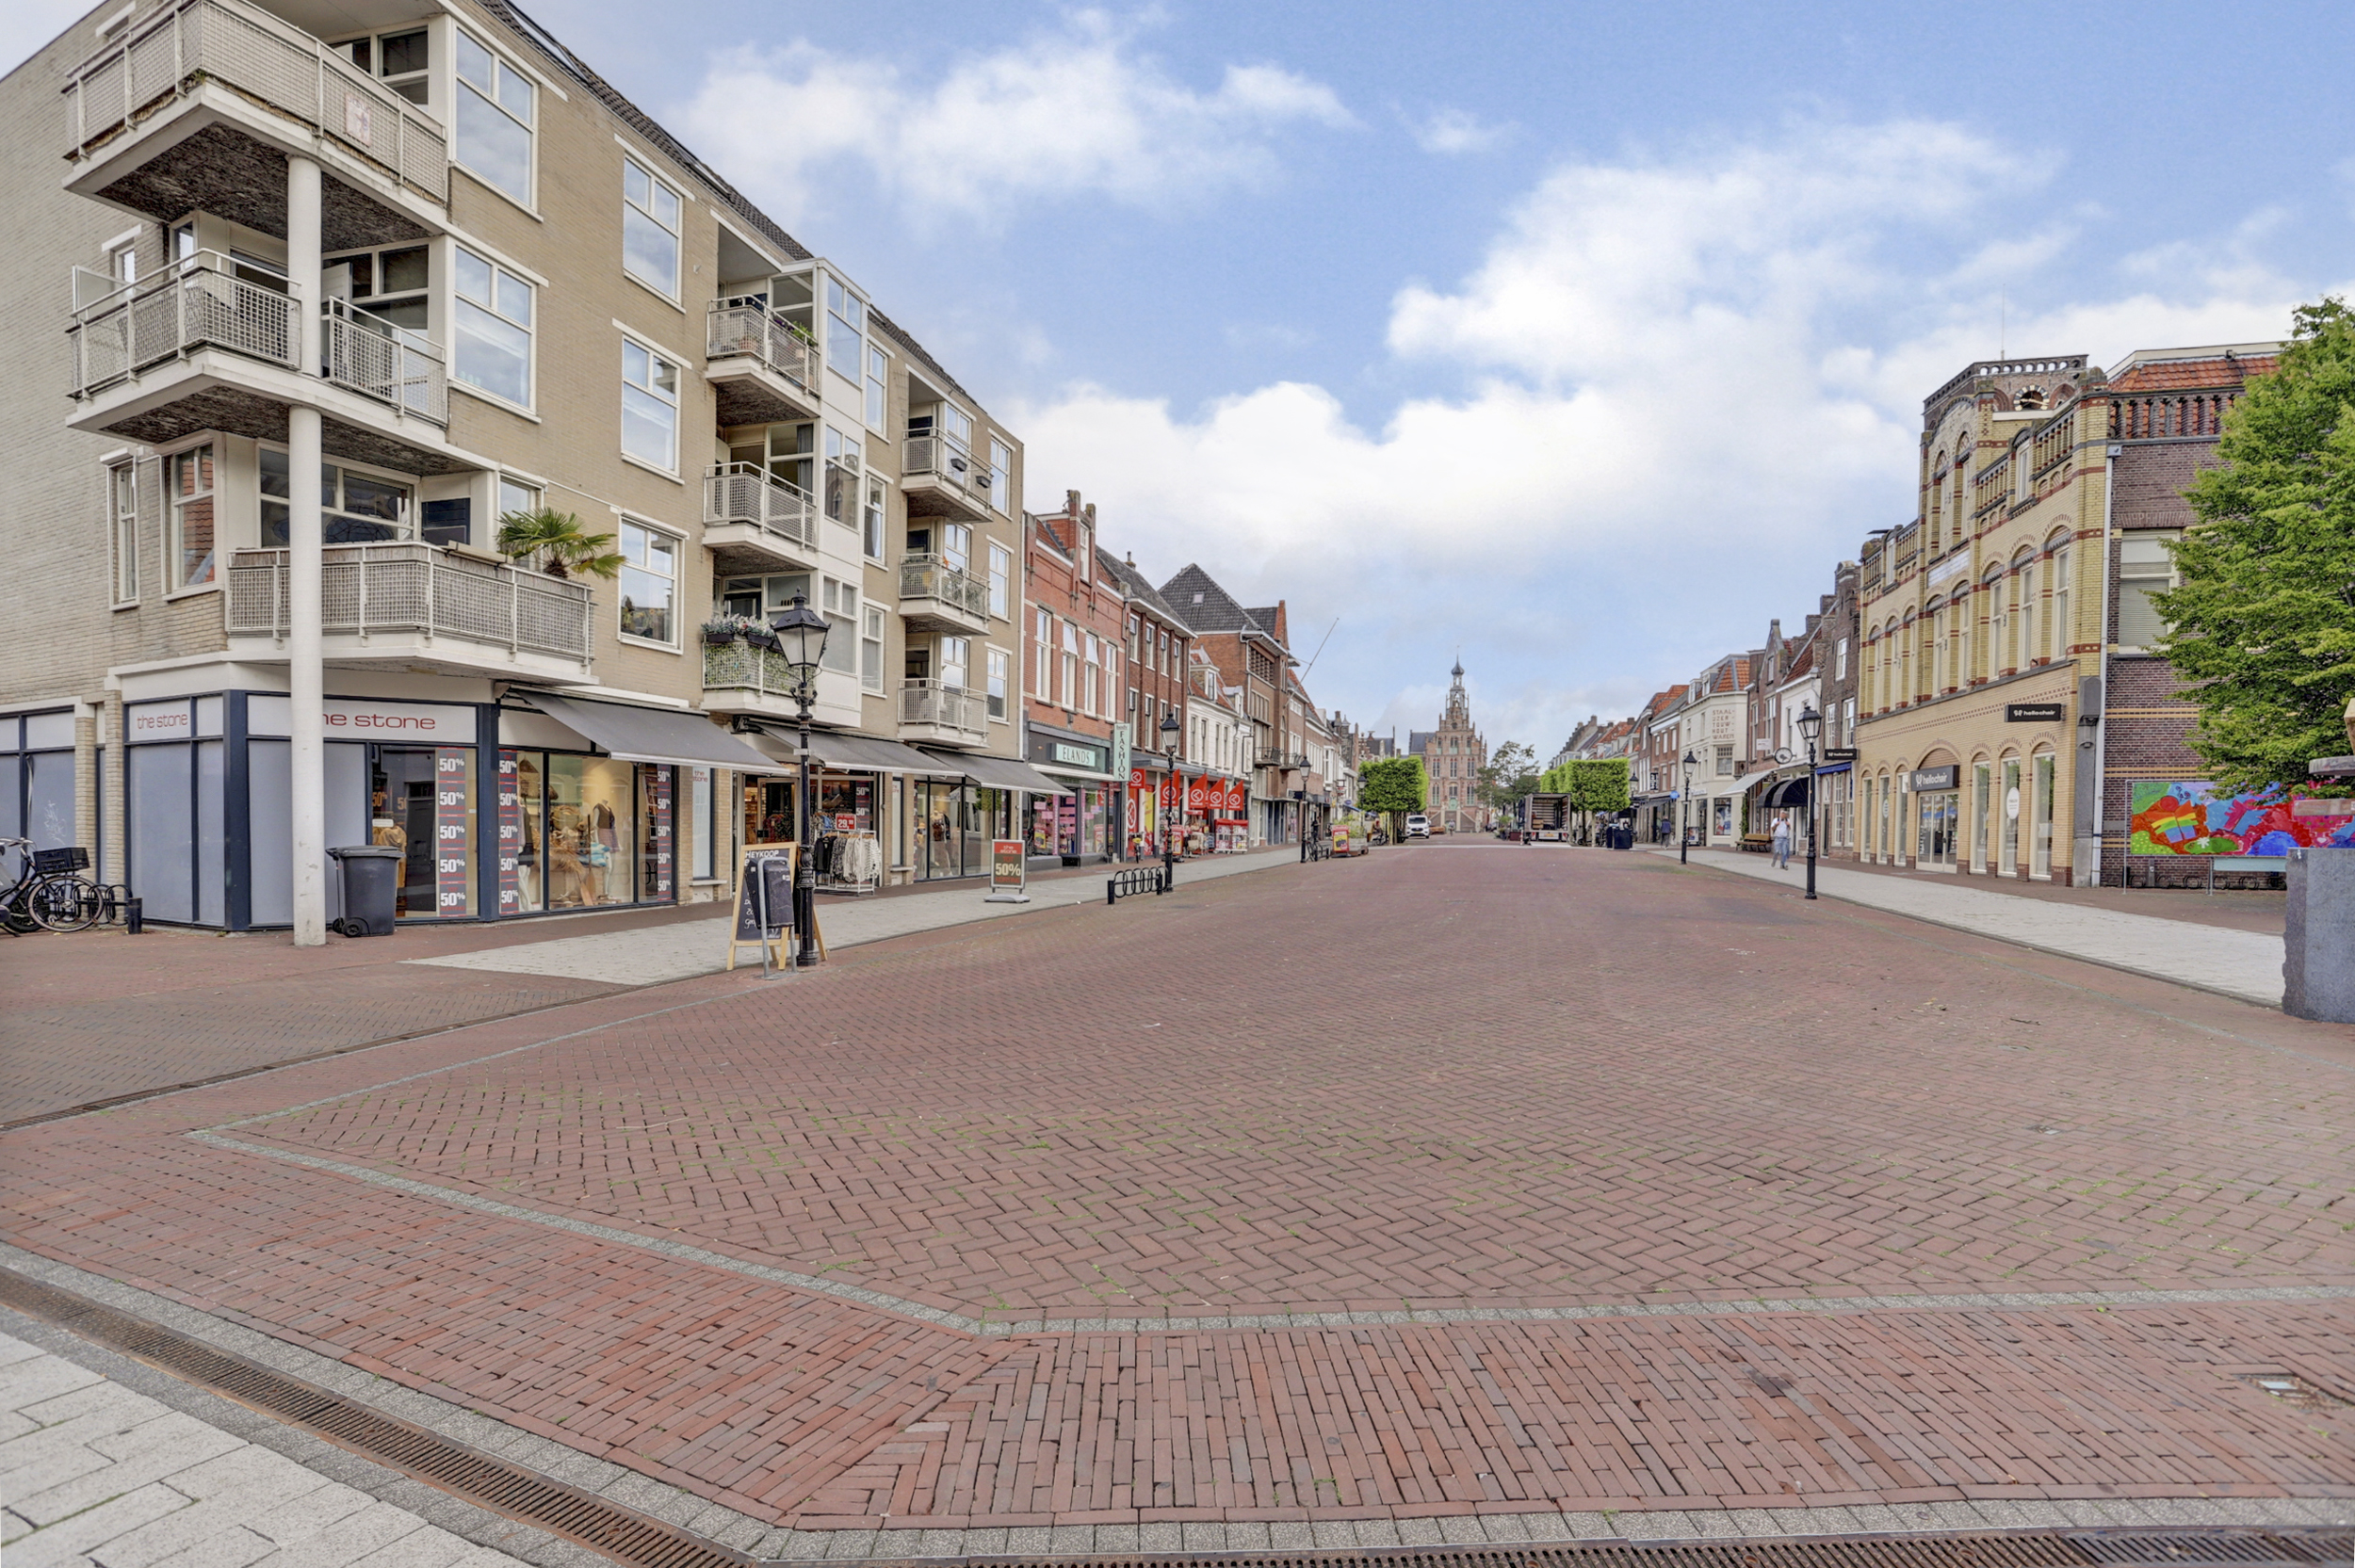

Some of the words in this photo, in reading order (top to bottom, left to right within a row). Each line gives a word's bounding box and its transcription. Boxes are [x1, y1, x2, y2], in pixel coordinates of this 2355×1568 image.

[137, 715, 155, 730] the
[156, 713, 188, 728] stone
[354, 713, 436, 730] stone
[1063, 747, 1090, 765] ELANDS
[1117, 731, 1126, 780] FASHION
[439, 757, 465, 772] 50%
[499, 760, 518, 774] 50%
[1923, 771, 1948, 785] hellochair
[439, 791, 465, 806] 50%
[499, 793, 518, 807] 50%
[439, 825, 465, 840] 50%
[499, 825, 518, 839] 50%
[745, 849, 779, 858] HEYKOOP
[439, 858, 465, 874] 50%
[500, 857, 518, 872] 50%
[995, 863, 1021, 877] 50%
[439, 892, 465, 907] 50%
[500, 890, 518, 904] 50%
